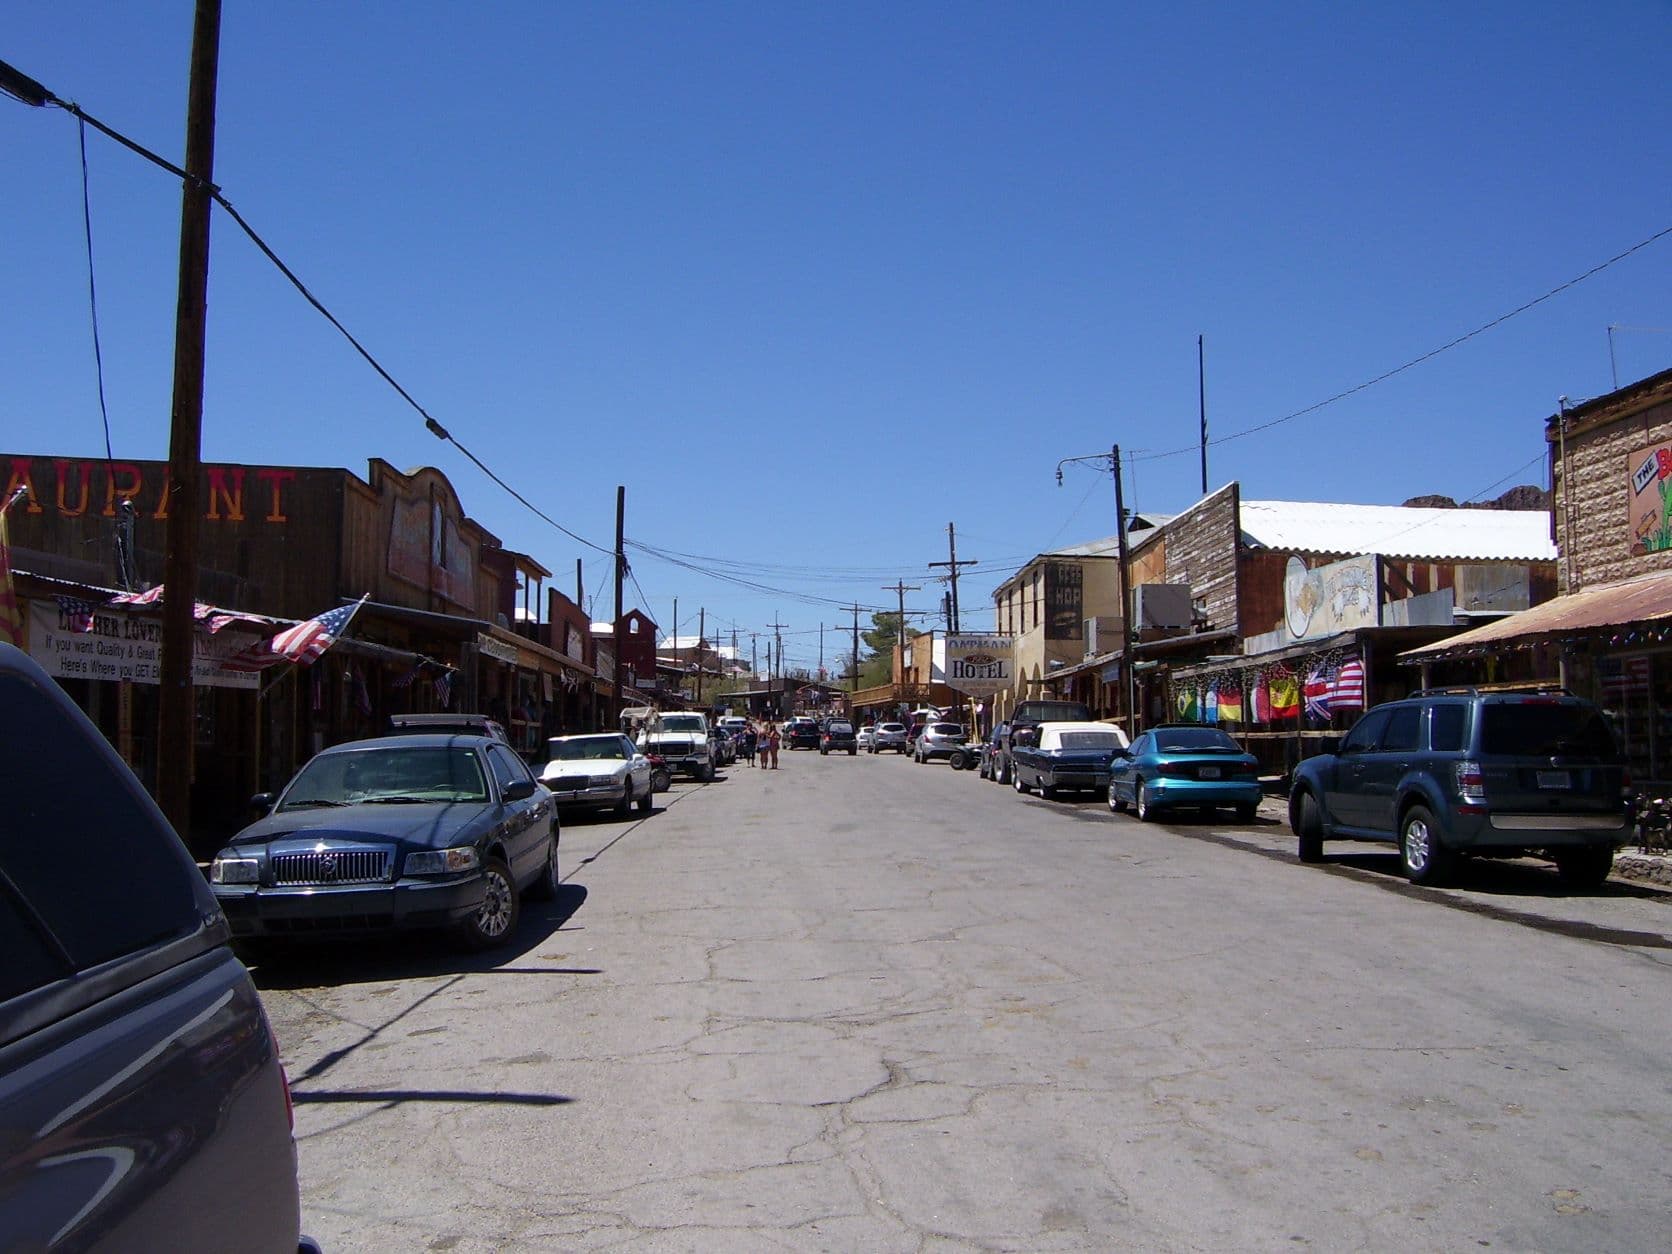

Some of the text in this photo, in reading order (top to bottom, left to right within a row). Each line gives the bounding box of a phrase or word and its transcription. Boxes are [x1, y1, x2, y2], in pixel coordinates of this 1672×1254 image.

[1637, 458, 1655, 484] THE
[58, 609, 120, 637] LHER
[56, 639, 71, 653] you
[74, 642, 93, 655] want
[96, 641, 125, 659] Quality
[61, 656, 87, 672] Here's
[90, 659, 116, 675] Where
[135, 663, 149, 678] GET
[952, 660, 1008, 679] HOTEL
